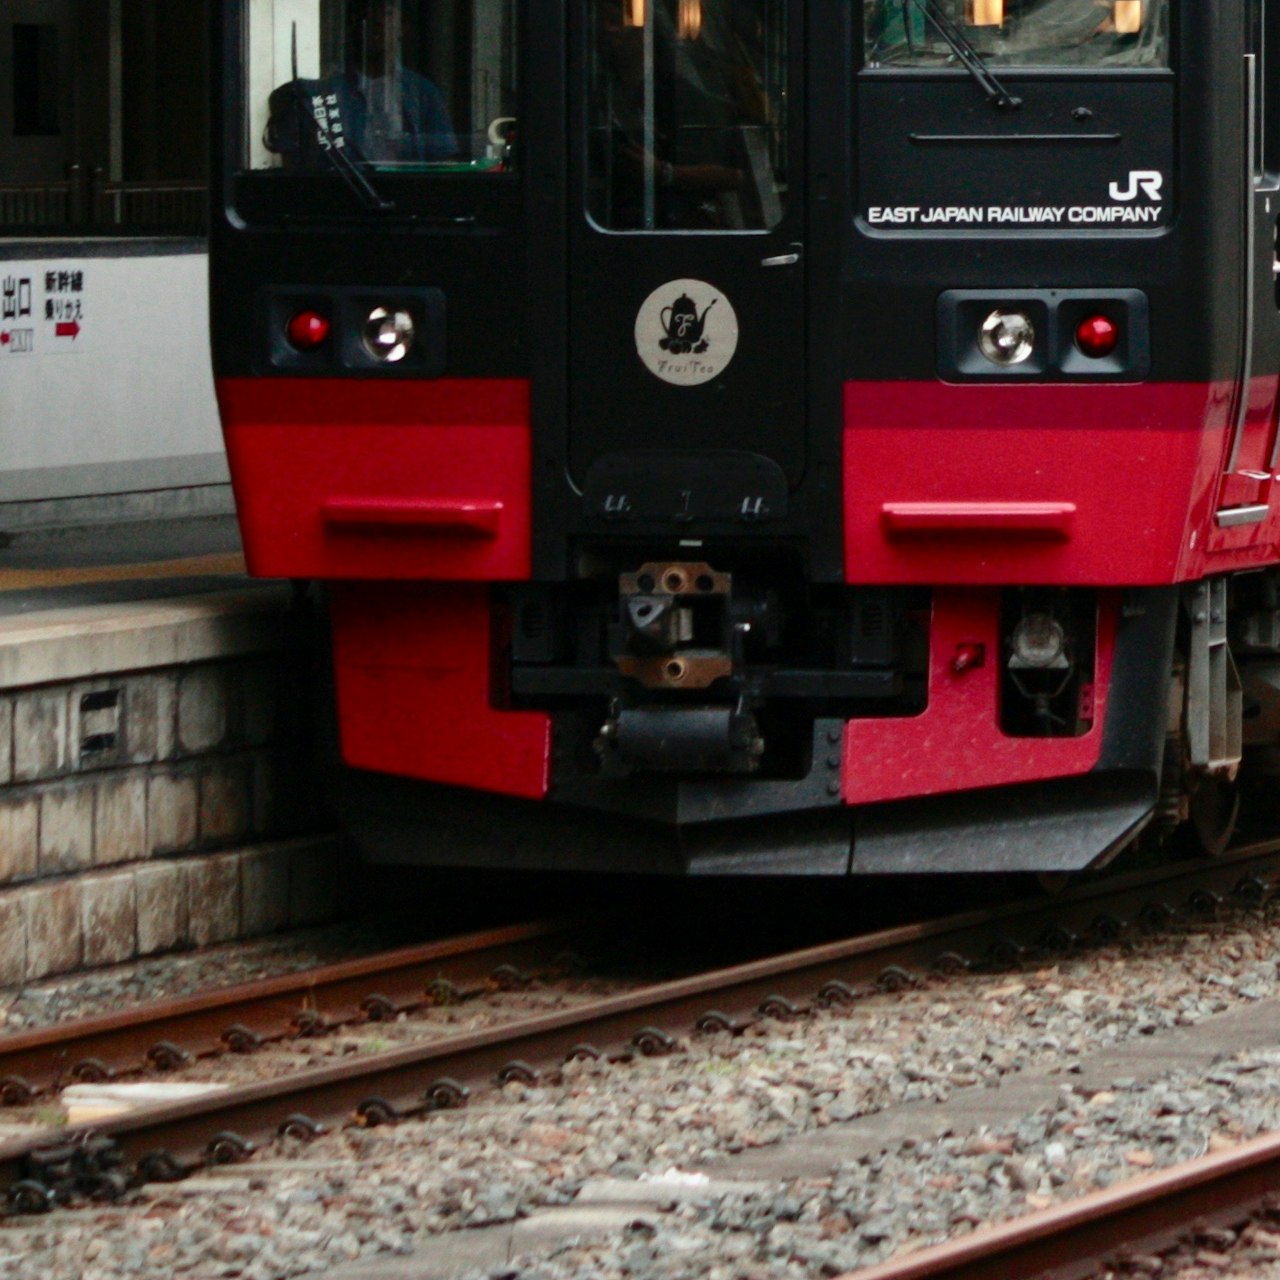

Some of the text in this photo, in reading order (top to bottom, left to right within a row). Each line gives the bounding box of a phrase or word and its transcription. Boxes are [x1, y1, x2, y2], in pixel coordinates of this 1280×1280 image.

[1108, 170, 1163, 202] JR
[868, 206, 1162, 223] EAST JAPAN RAILWAY COMPANY
[45, 269, 84, 293] 新幹線
[3, 275, 32, 320] 出口
[45, 298, 84, 321] 乗りかえ
[657, 359, 715, 375] FruiTea
